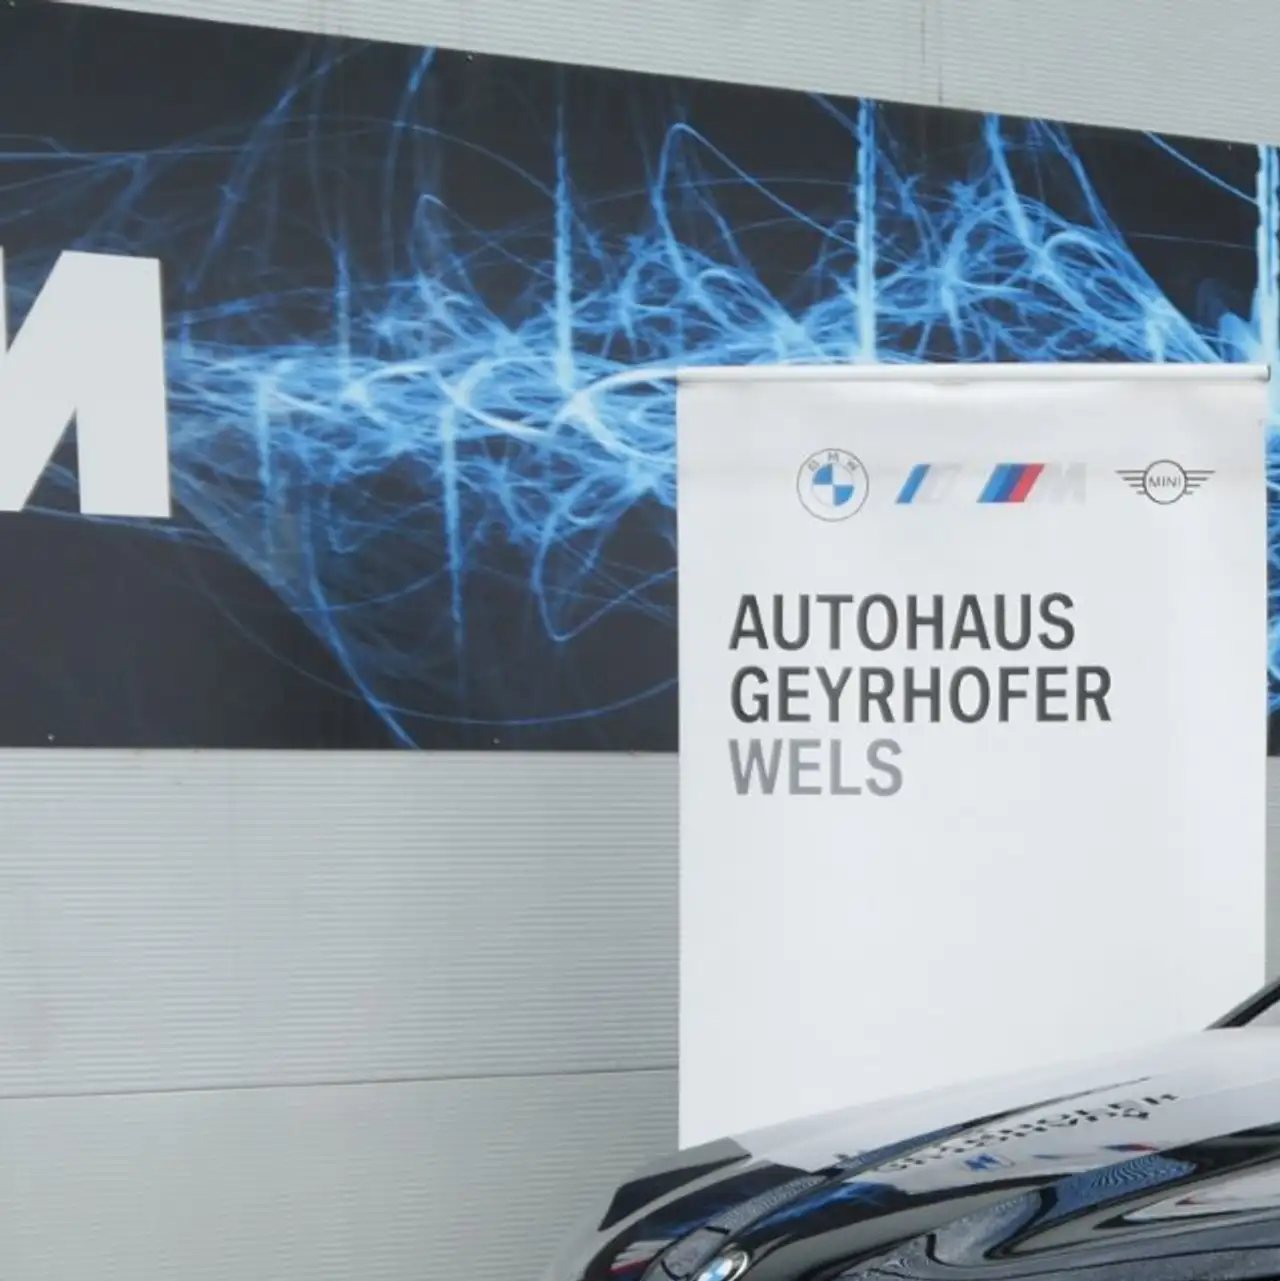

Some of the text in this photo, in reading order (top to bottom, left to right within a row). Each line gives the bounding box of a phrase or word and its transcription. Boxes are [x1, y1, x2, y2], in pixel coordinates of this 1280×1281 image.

[806, 450, 860, 472] BMW
[1148, 474, 1183, 488] MINI
[728, 592, 1077, 652] AUTOHAUS
[729, 664, 1113, 724] GEYRHOFER
[727, 738, 905, 798] WELS
